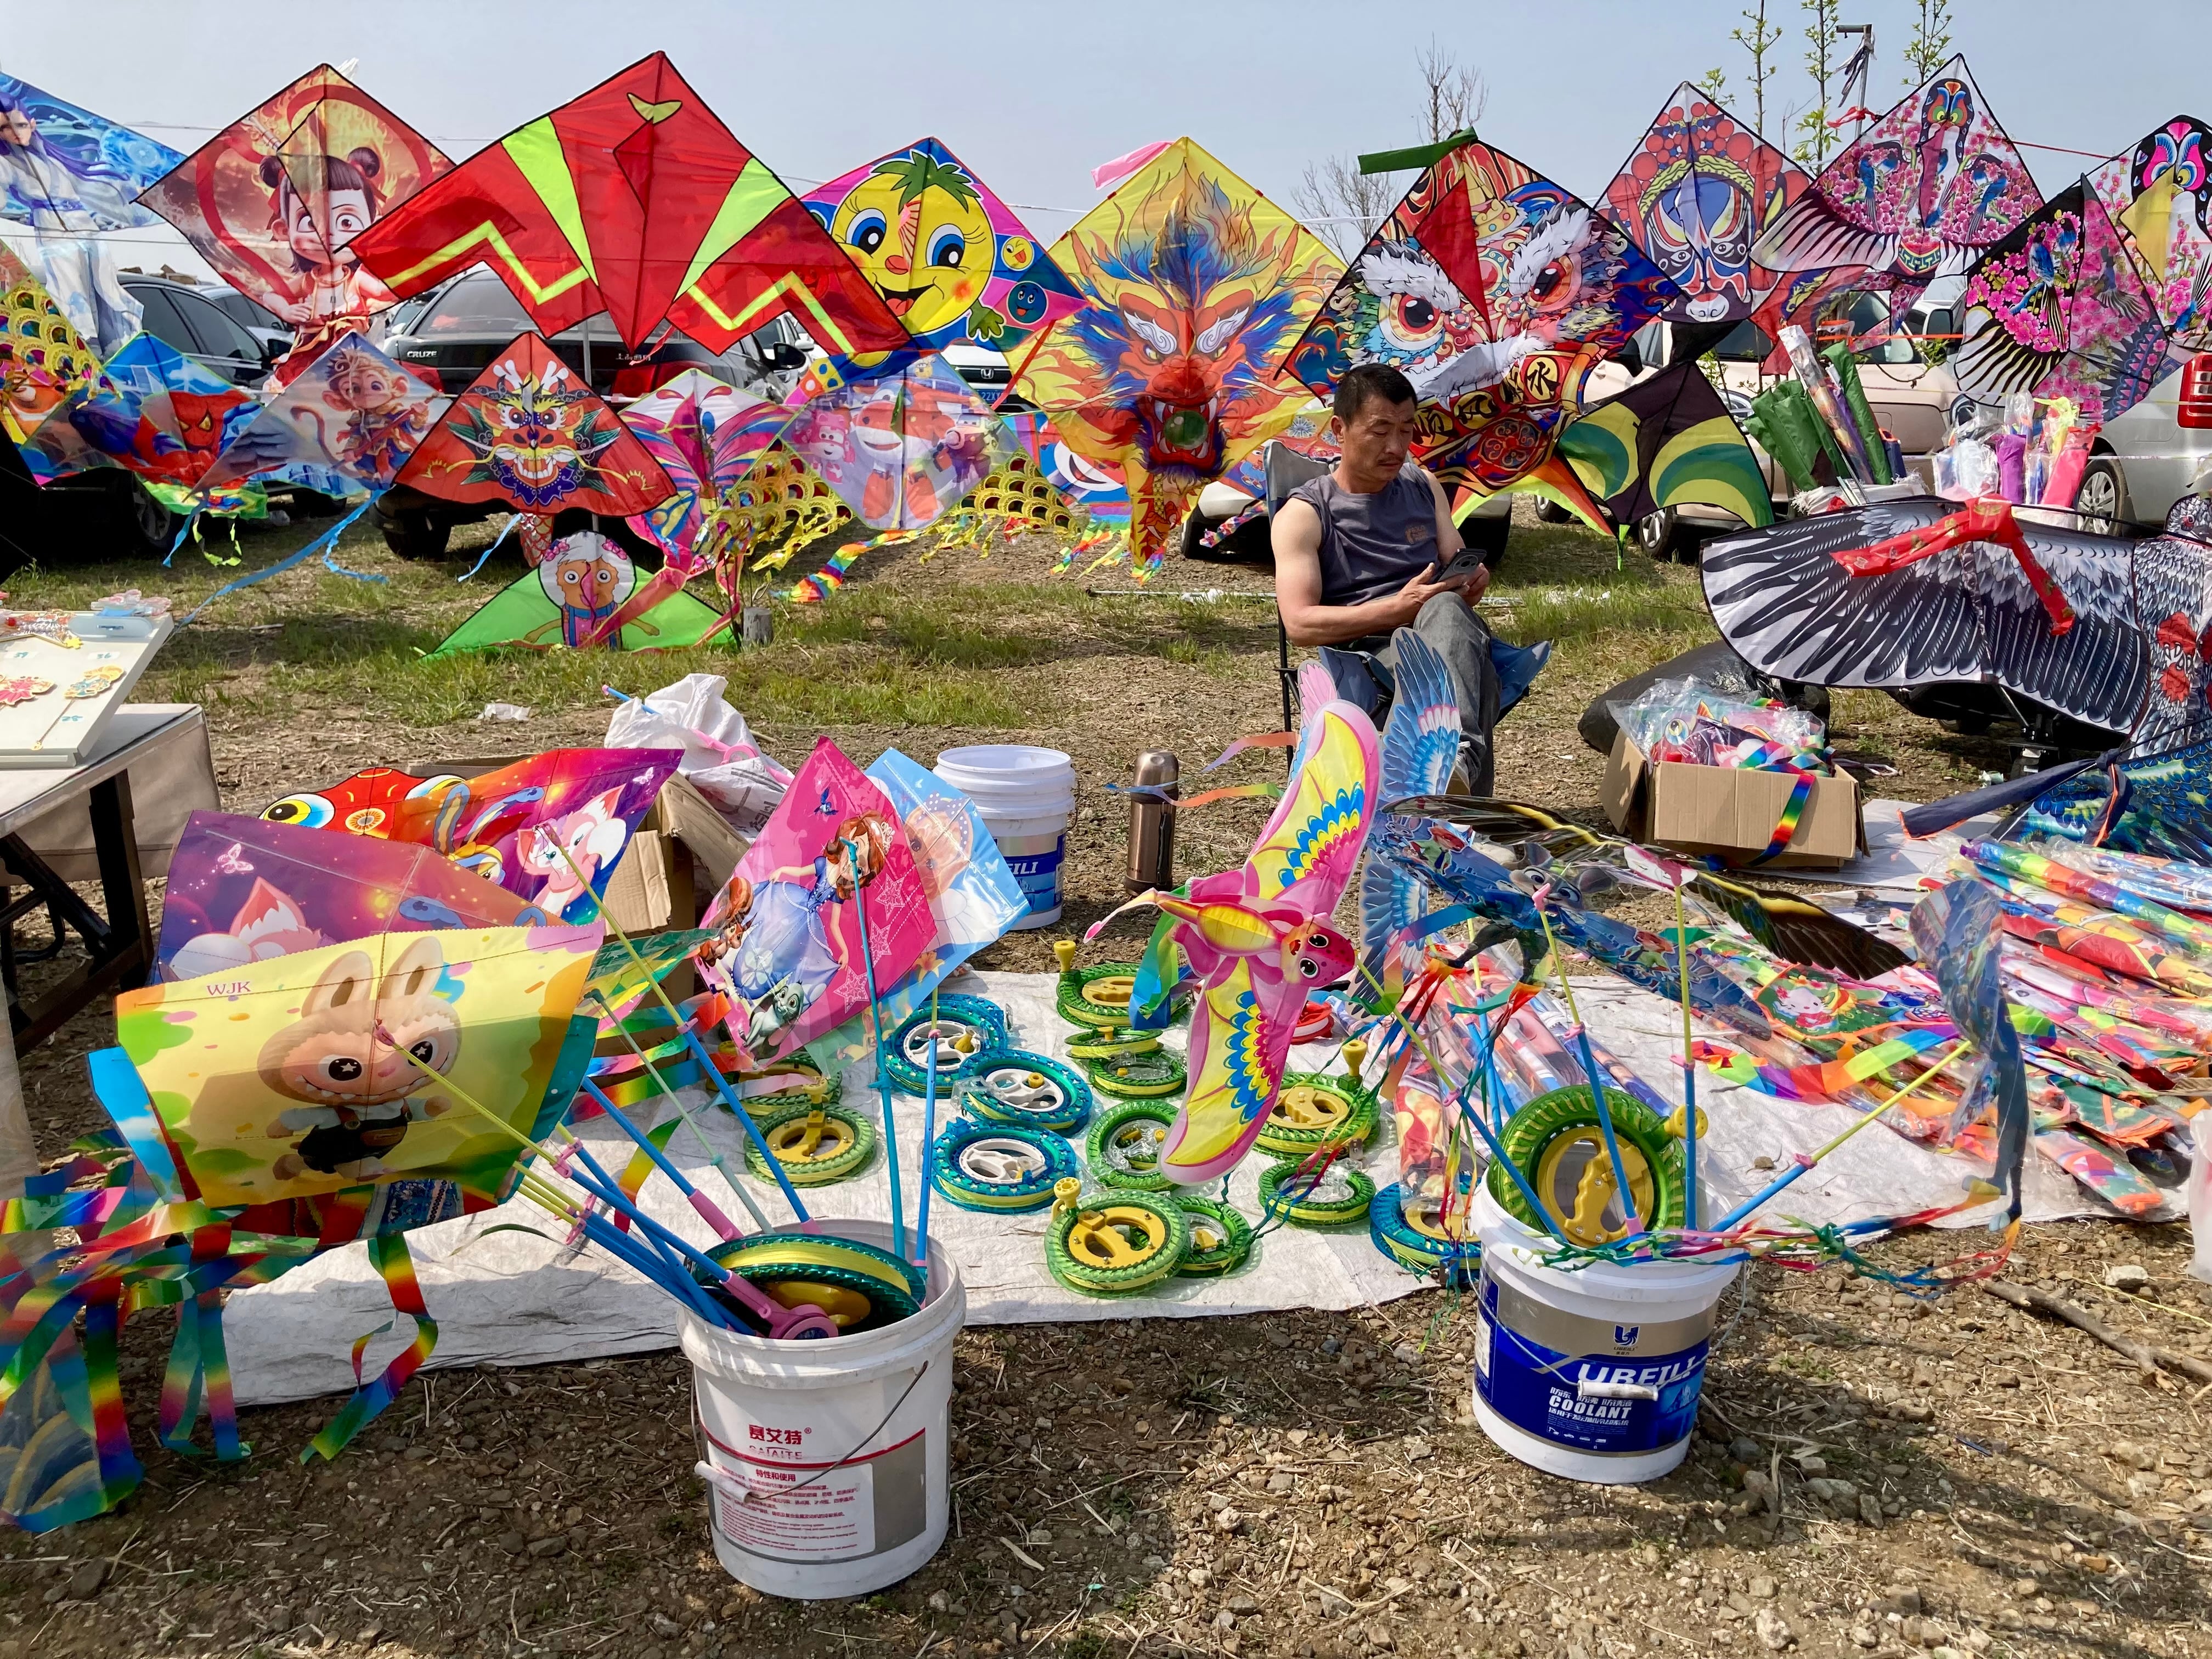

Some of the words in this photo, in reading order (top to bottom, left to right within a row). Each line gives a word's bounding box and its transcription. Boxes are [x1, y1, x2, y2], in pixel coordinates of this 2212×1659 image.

[206, 981, 251, 996] WJK
[1578, 1355, 1696, 1387] UBEILI
[1549, 1395, 1632, 1419] COOLANT
[755, 1468, 796, 1482] 特性和使用
